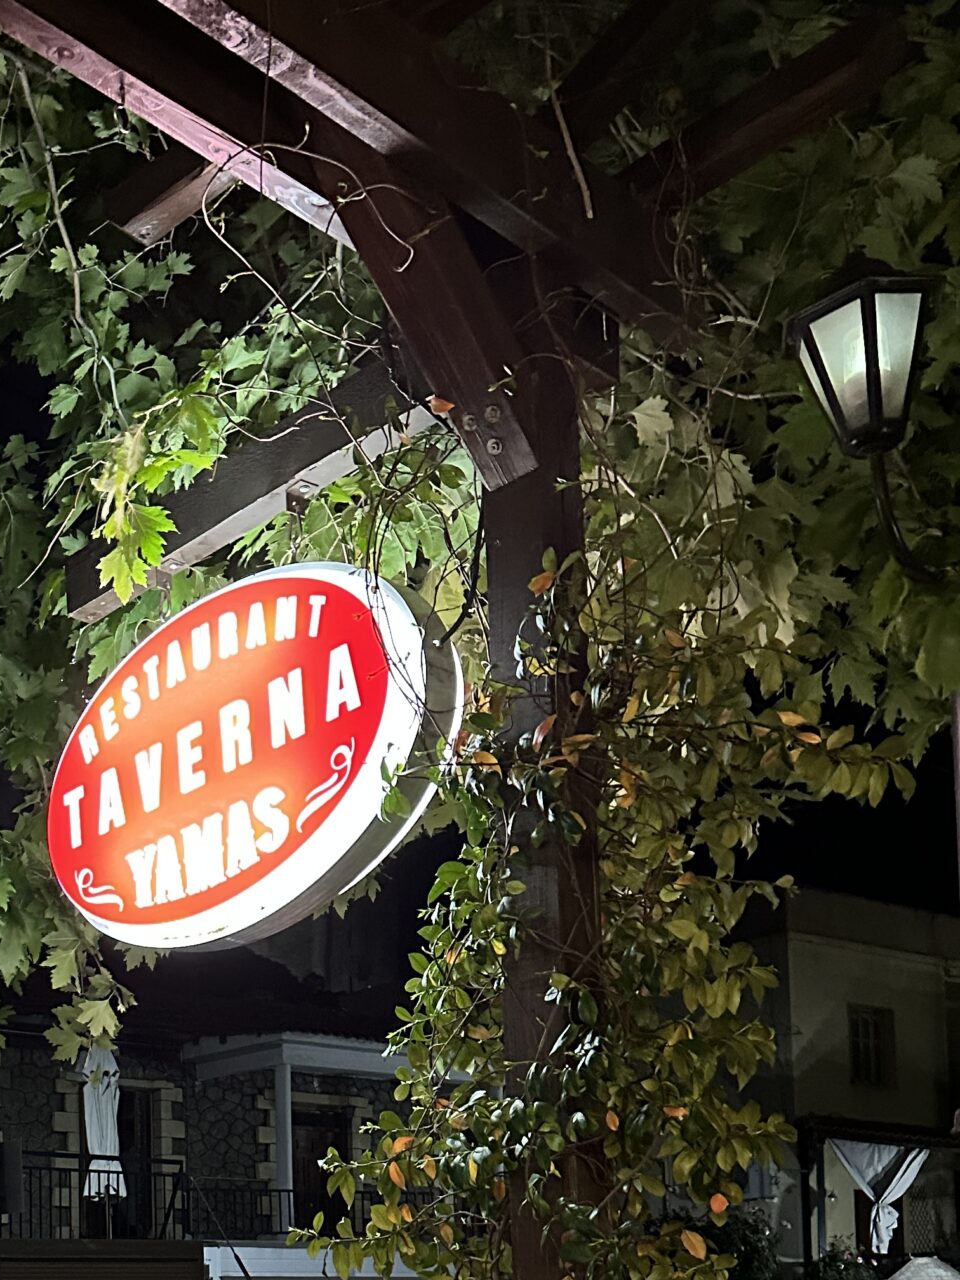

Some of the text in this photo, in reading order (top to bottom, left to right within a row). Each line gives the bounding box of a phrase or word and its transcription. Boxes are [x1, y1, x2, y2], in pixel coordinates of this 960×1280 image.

[63, 643, 361, 849] TAVERNA
[78, 595, 327, 764] RESTAURANT
[124, 786, 290, 908] YAMAS
